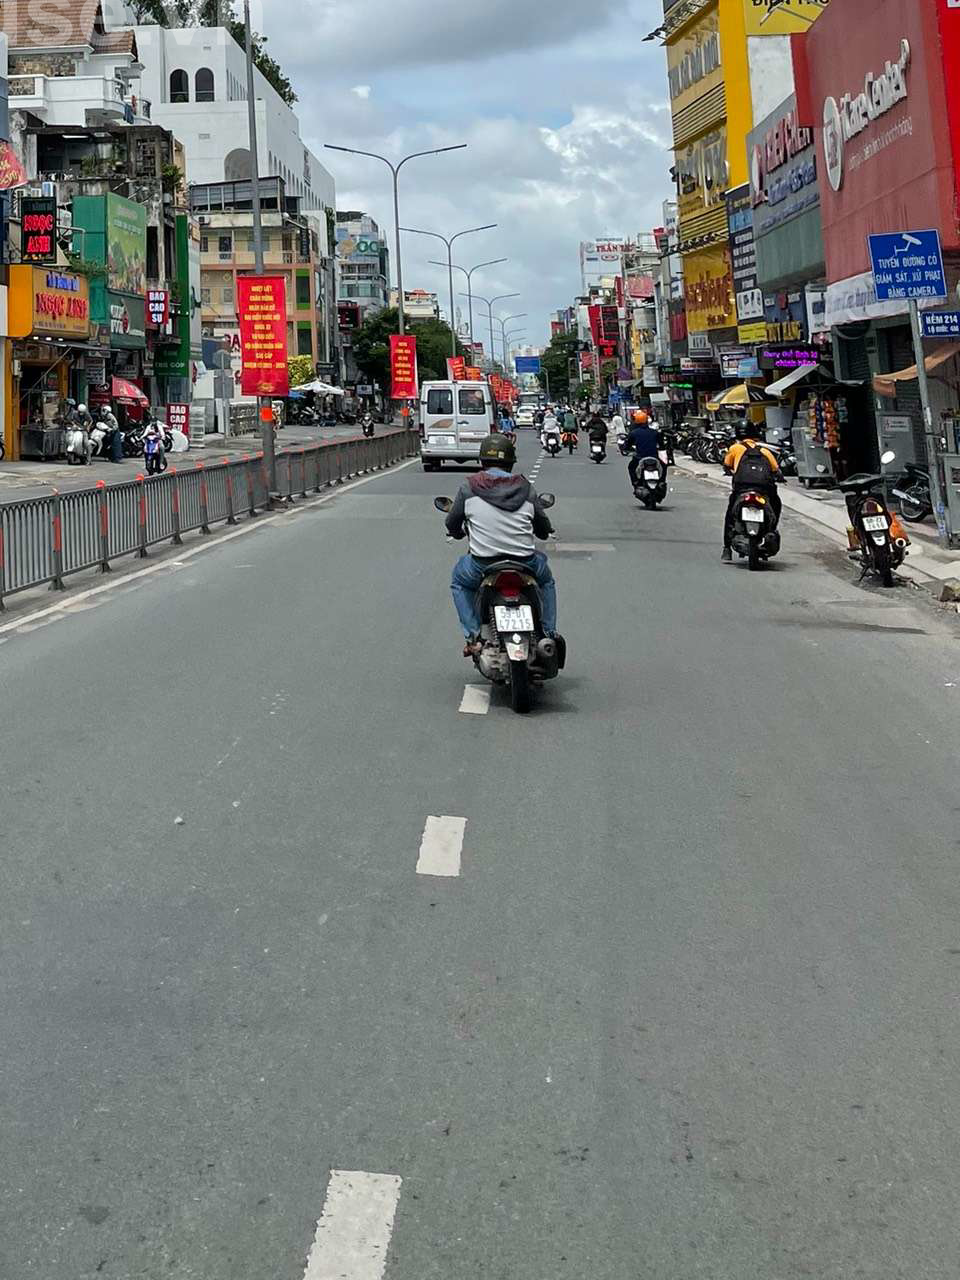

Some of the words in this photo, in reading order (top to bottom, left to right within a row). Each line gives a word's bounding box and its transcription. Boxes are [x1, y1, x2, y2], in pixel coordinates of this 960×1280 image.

[24, 214, 53, 234] NGỌC
[26, 235, 51, 253] ANH
[878, 255, 900, 269] TUYẾN
[902, 255, 926, 267] ĐƯỜNG
[927, 252, 938, 265] CÓ
[876, 271, 893, 284] GIÁM
[912, 268, 922, 282] XỬ
[924, 270, 941, 282] PHẠT
[148, 291, 165, 302] BAO
[887, 285, 906, 298] BẰNG
[907, 286, 937, 297] CAMERA
[149, 303, 165, 313] CAO
[151, 313, 163, 324] SU
[944, 314, 958, 324] 214
[170, 406, 186, 414] BAO
[170, 415, 186, 423] CAO
